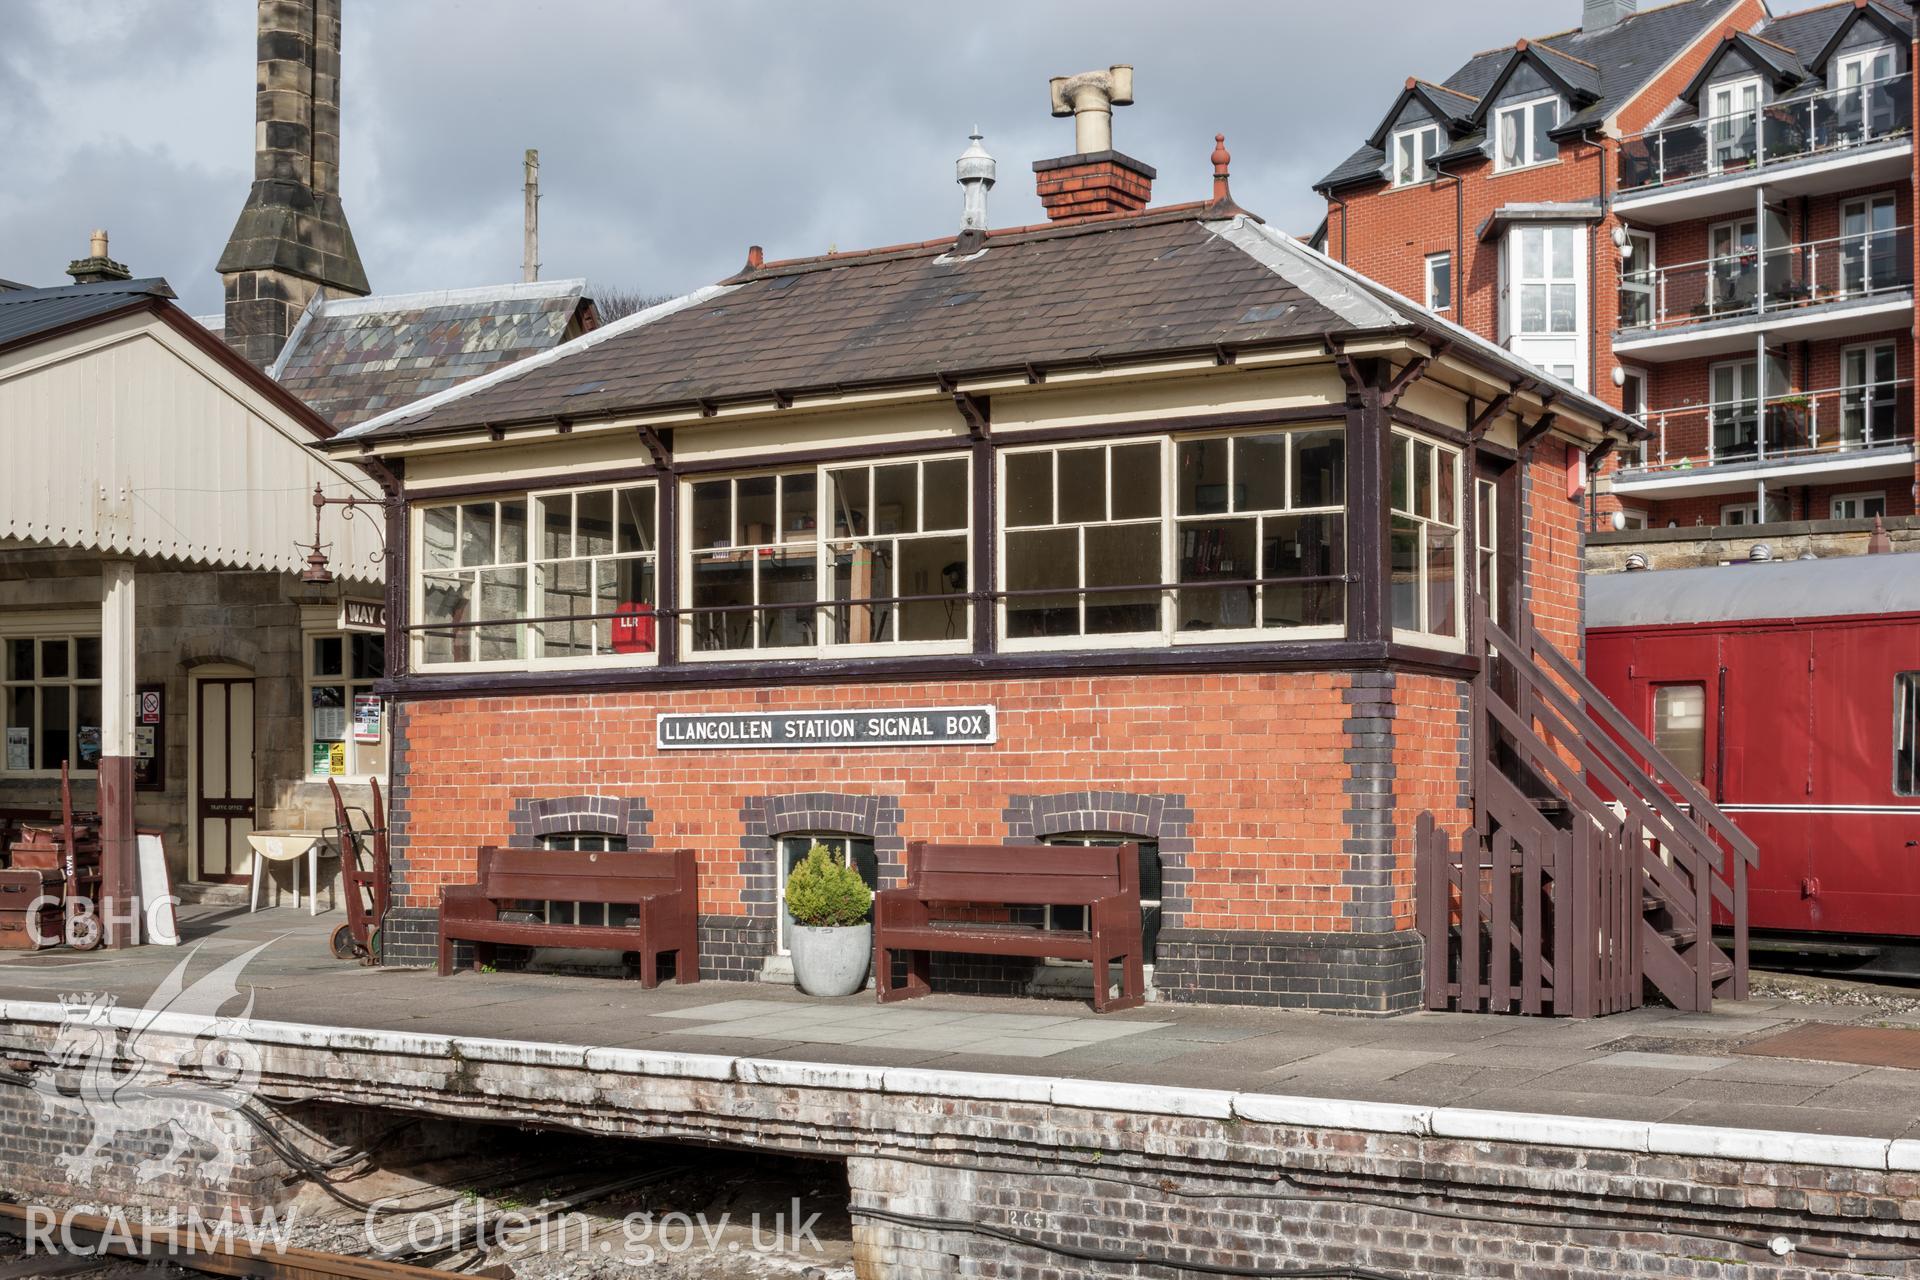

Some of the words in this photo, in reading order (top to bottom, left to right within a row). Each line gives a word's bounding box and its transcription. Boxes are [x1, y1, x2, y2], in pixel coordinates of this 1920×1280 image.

[348, 604, 375, 624] WAY
[621, 617, 639, 627] LLR
[665, 720, 772, 740] LLANGOLLEN
[784, 719, 855, 738] STATION
[868, 717, 934, 736] SIGNAL
[946, 715, 982, 735] BOX
